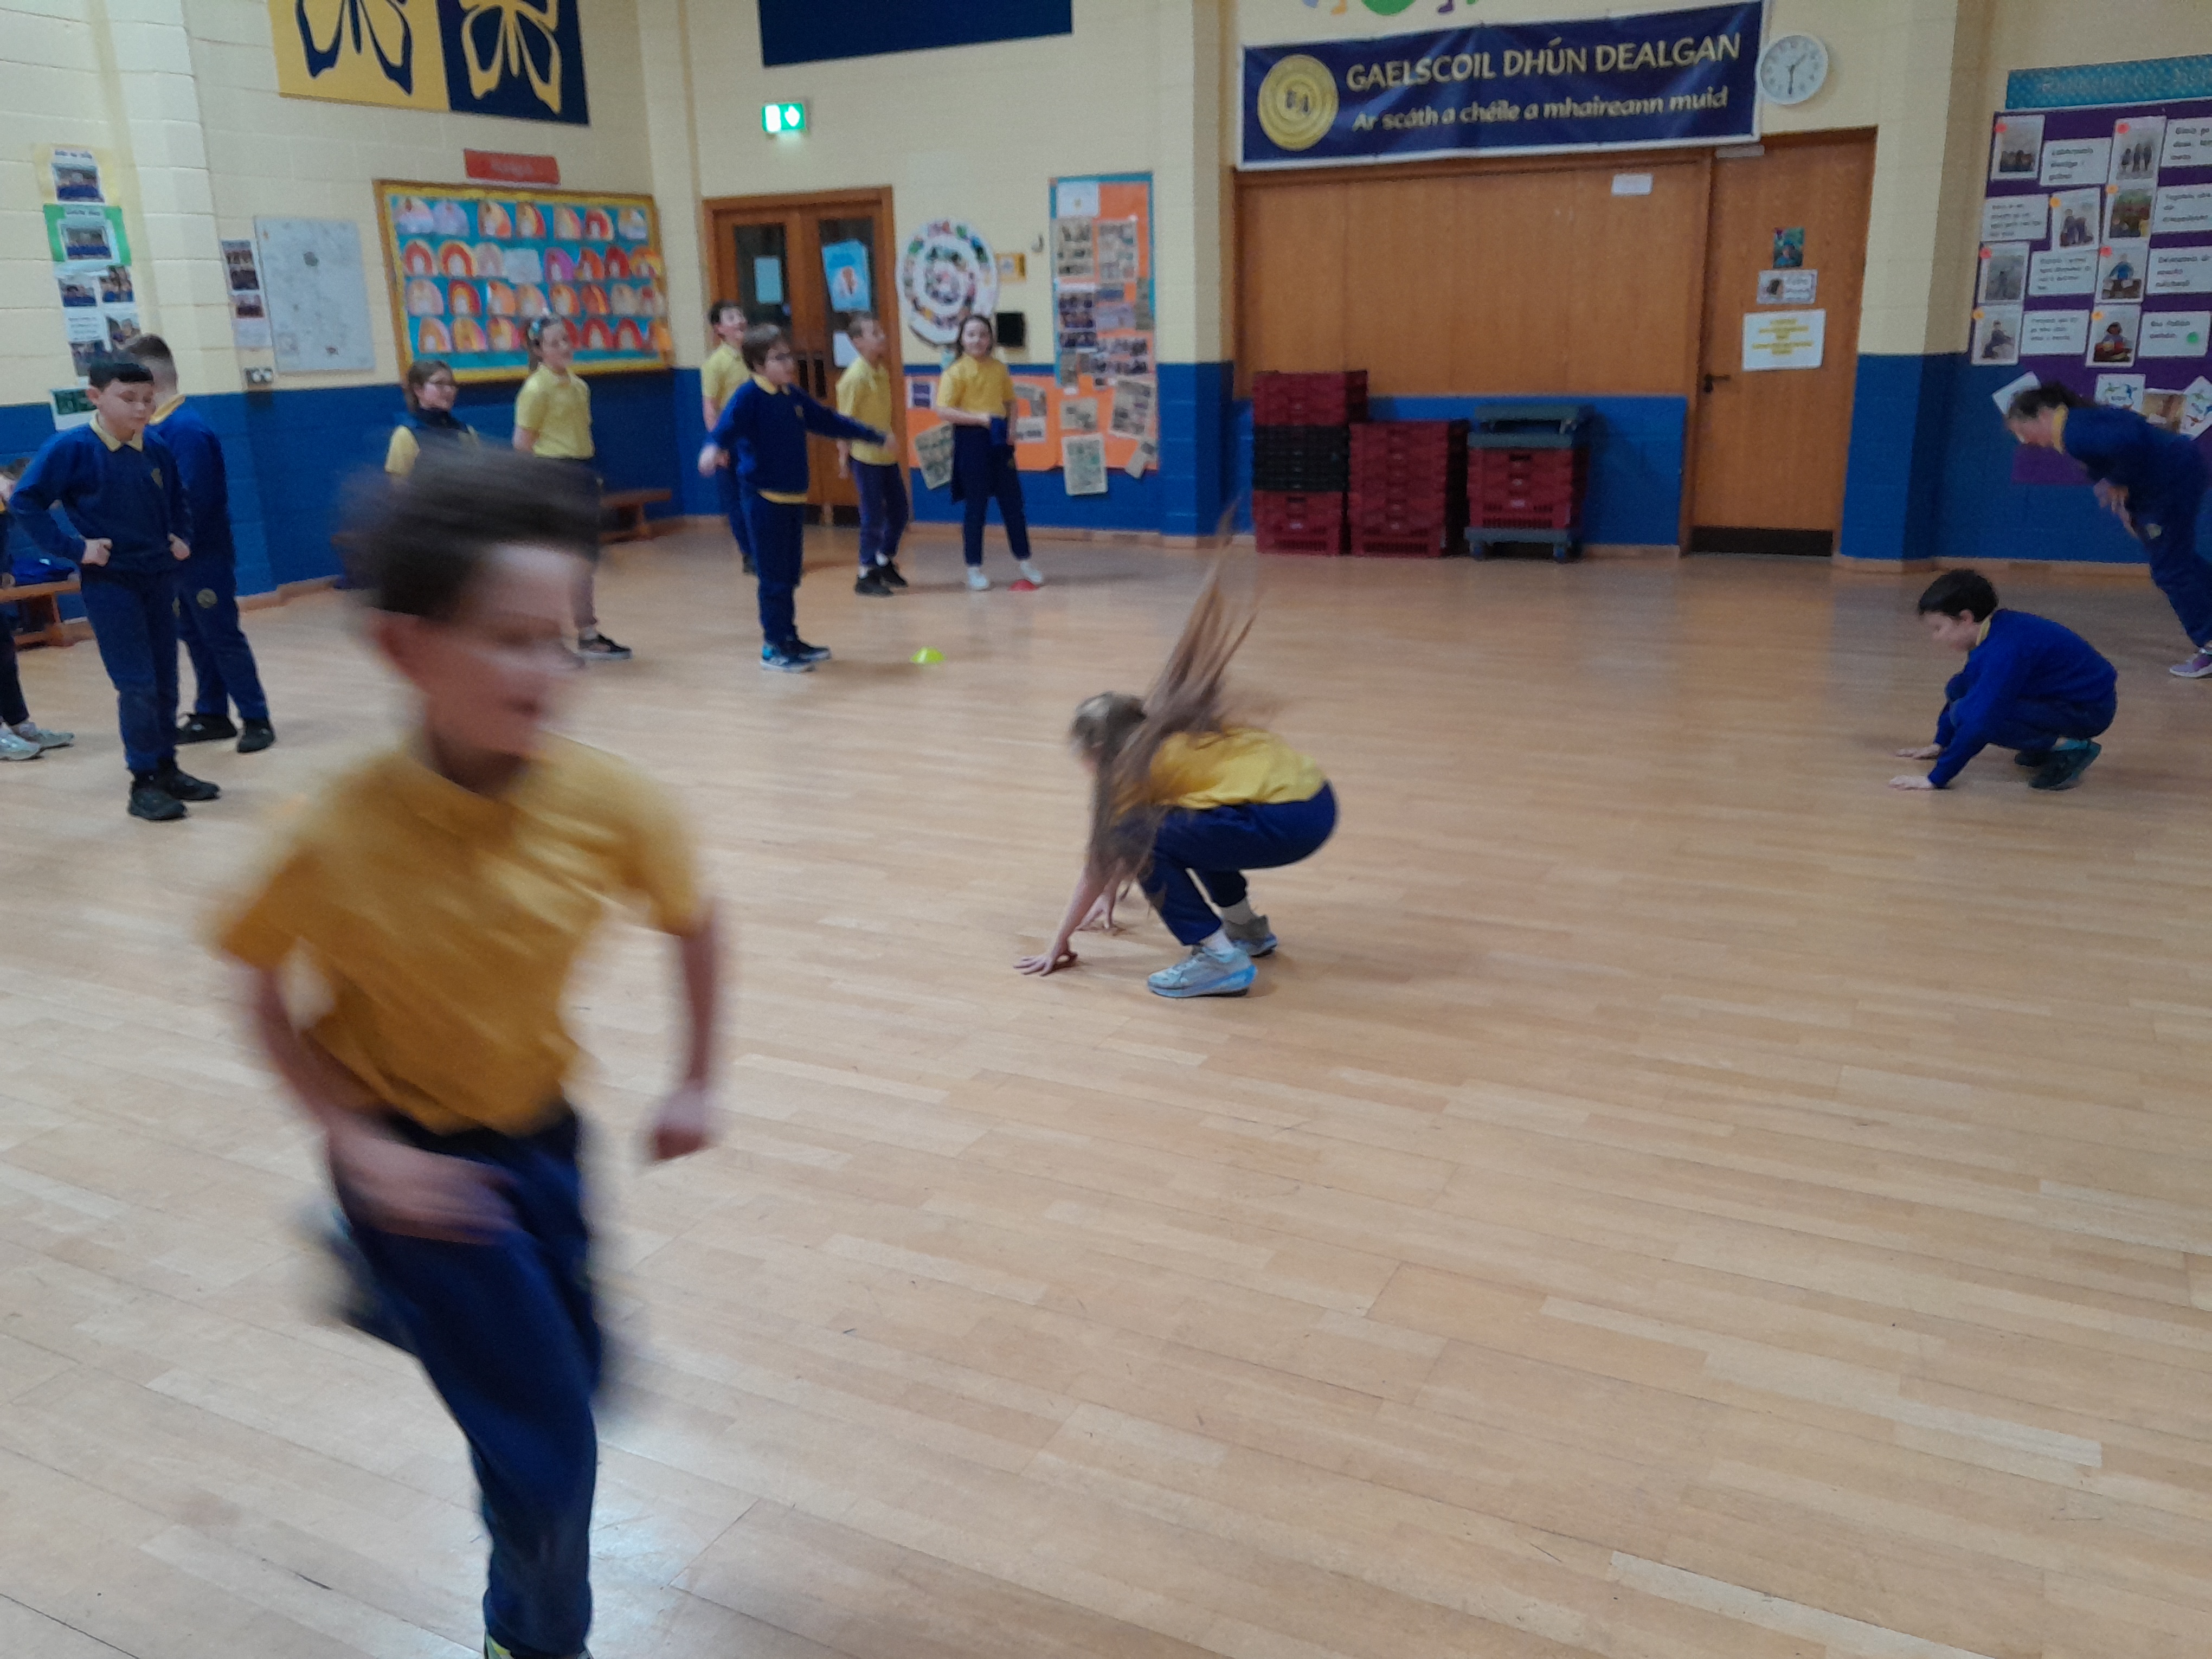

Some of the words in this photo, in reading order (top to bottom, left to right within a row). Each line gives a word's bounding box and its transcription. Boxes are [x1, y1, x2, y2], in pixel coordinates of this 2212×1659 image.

[1346, 53, 1496, 91] GAELSCOIL
[1503, 36, 1588, 78] DHÚN
[1596, 33, 1741, 72] DEALGAN
[1352, 111, 1378, 131] Ar
[1442, 107, 1456, 125] a
[1523, 103, 1539, 120] a
[1543, 96, 1664, 119] mhaireann
[1669, 85, 1729, 111] muid
